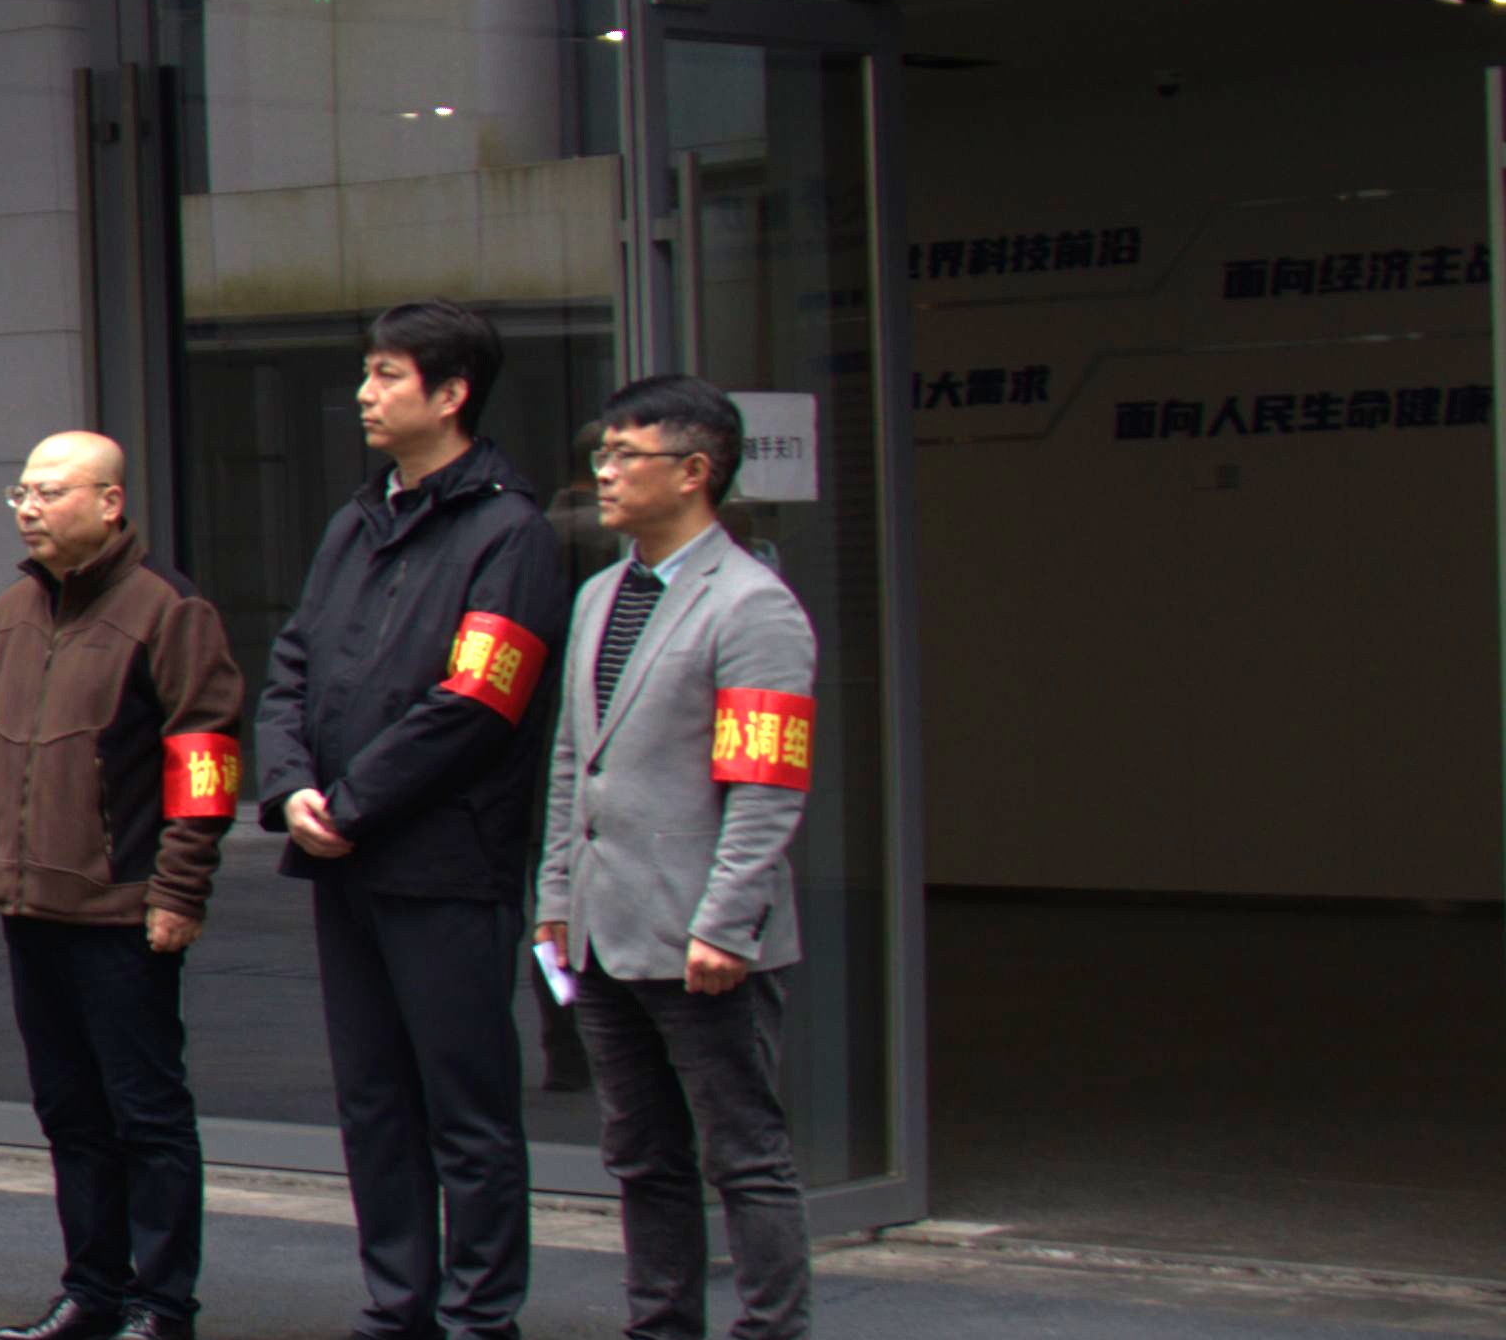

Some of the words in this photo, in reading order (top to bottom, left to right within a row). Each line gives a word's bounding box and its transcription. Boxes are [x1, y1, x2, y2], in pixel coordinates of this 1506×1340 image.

[912, 365, 1049, 411] 大需求
[447, 630, 523, 696] 调组
[712, 707, 809, 769] 协调组
